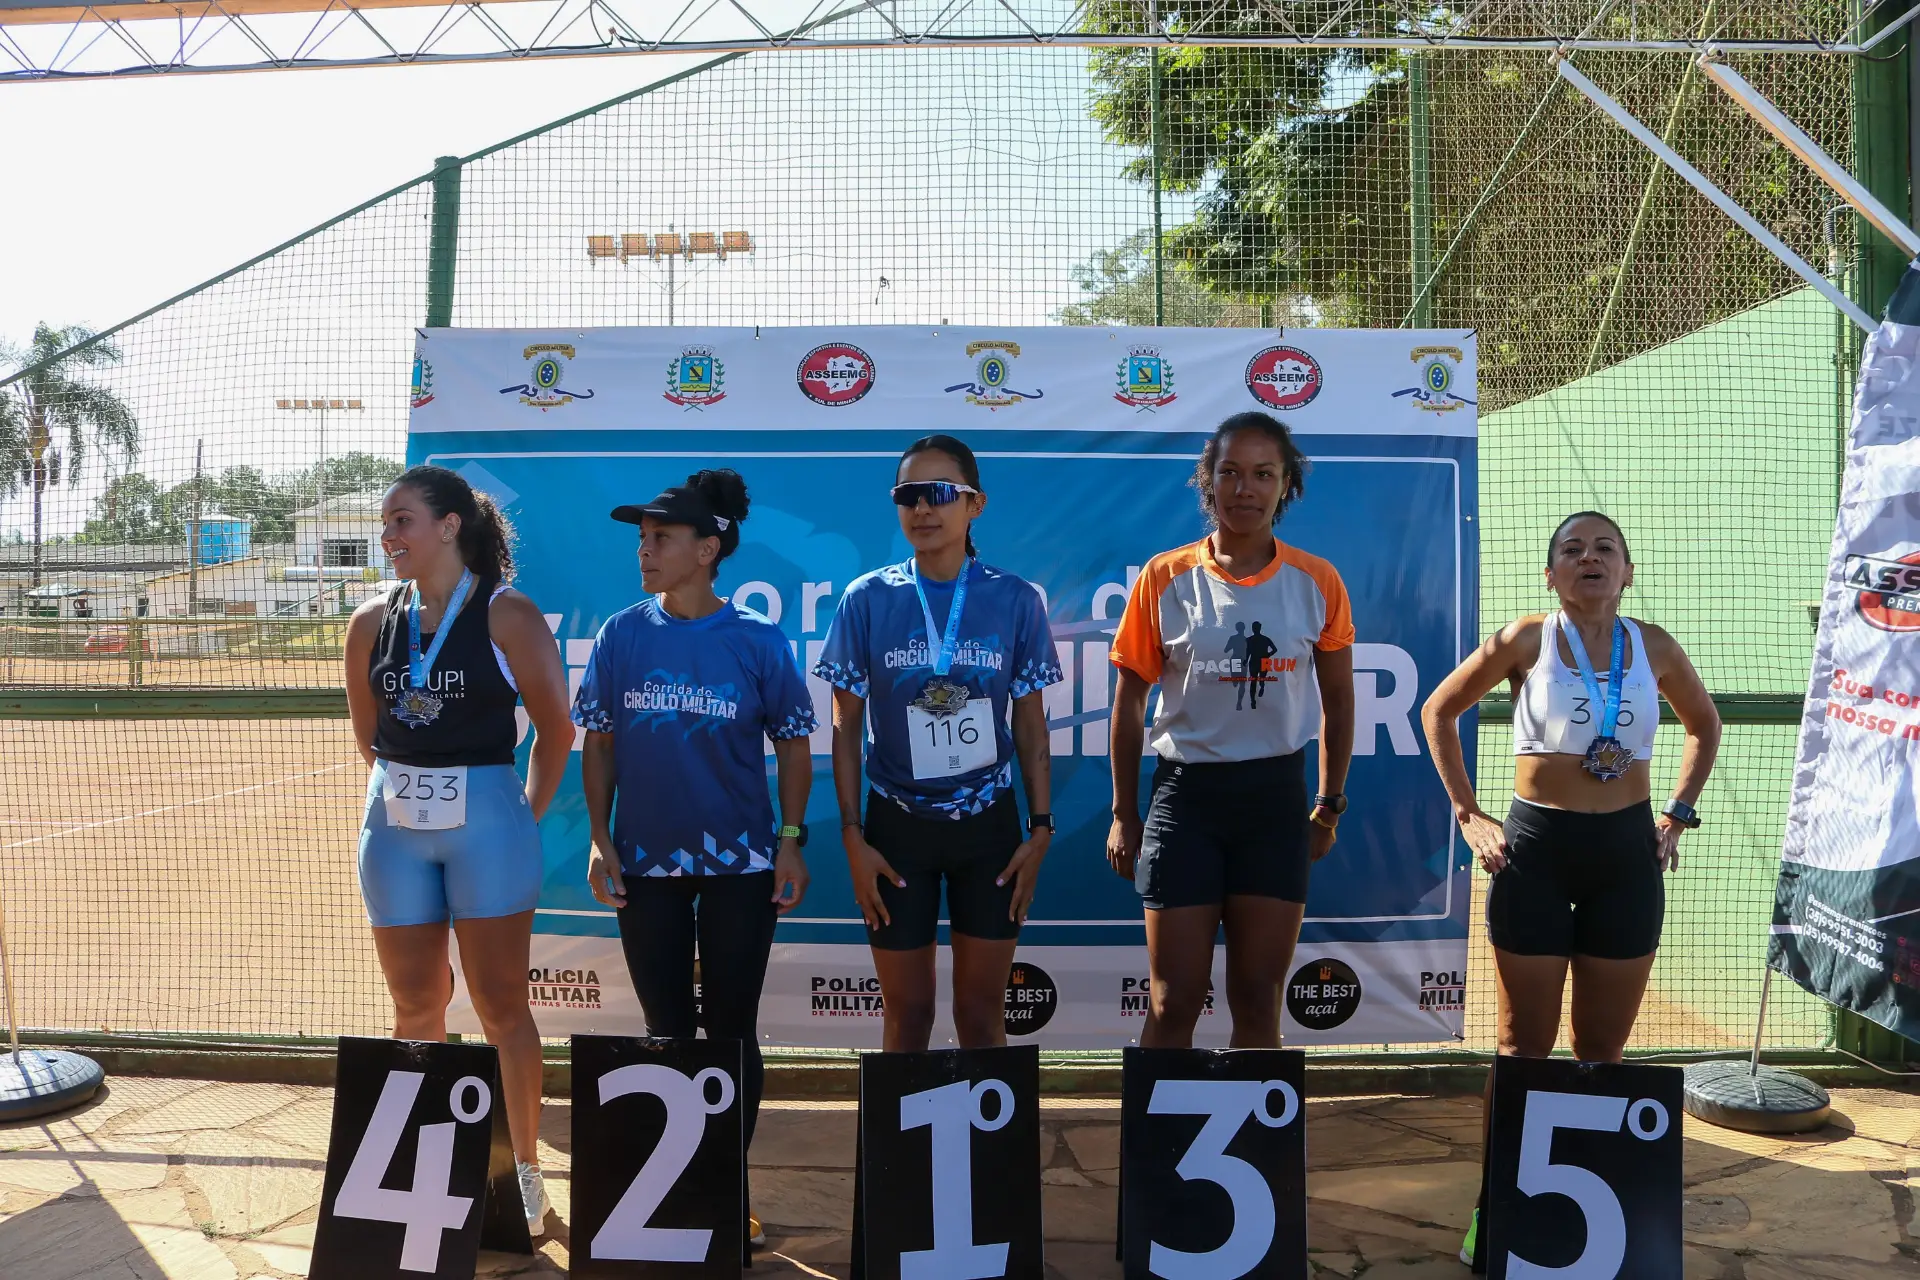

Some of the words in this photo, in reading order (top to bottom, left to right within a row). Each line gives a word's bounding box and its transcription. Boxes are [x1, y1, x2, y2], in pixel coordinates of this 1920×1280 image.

[805, 370, 868, 379] ASSEEMG
[1253, 373, 1315, 383] ASSEEMG
[836, 397, 857, 406] MINAS
[1286, 401, 1305, 409] MINAS
[964, 639, 980, 649] do
[951, 649, 1003, 671] MILITAR
[1193, 658, 1242, 674] PACE
[1261, 658, 1297, 673] RUN
[427, 670, 465, 691] UP!
[644, 681, 692, 695] Corrida
[697, 686, 713, 697] do
[1831, 669, 1873, 699] Sua
[624, 688, 678, 710] CÍRCULO
[681, 695, 737, 719] MILITAR
[1570, 697, 1634, 727] 36
[1826, 701, 1897, 736] nossa
[925, 717, 979, 747] 116
[395, 773, 459, 801] 253
[1805, 906, 1884, 954] (35)99951-3003
[1803, 922, 1884, 972] (35)99987-4004
[528, 968, 600, 985] OLÍCIA
[811, 977, 881, 992] POLÍC
[529, 986, 601, 1003] ILITAR
[1017, 988, 1052, 1003] BEST
[1293, 985, 1318, 999] THE
[1322, 984, 1357, 998] BEST
[529, 1000, 561, 1008] MINAS
[811, 995, 885, 1011] MILITA
[1305, 1001, 1337, 1018] açaí
